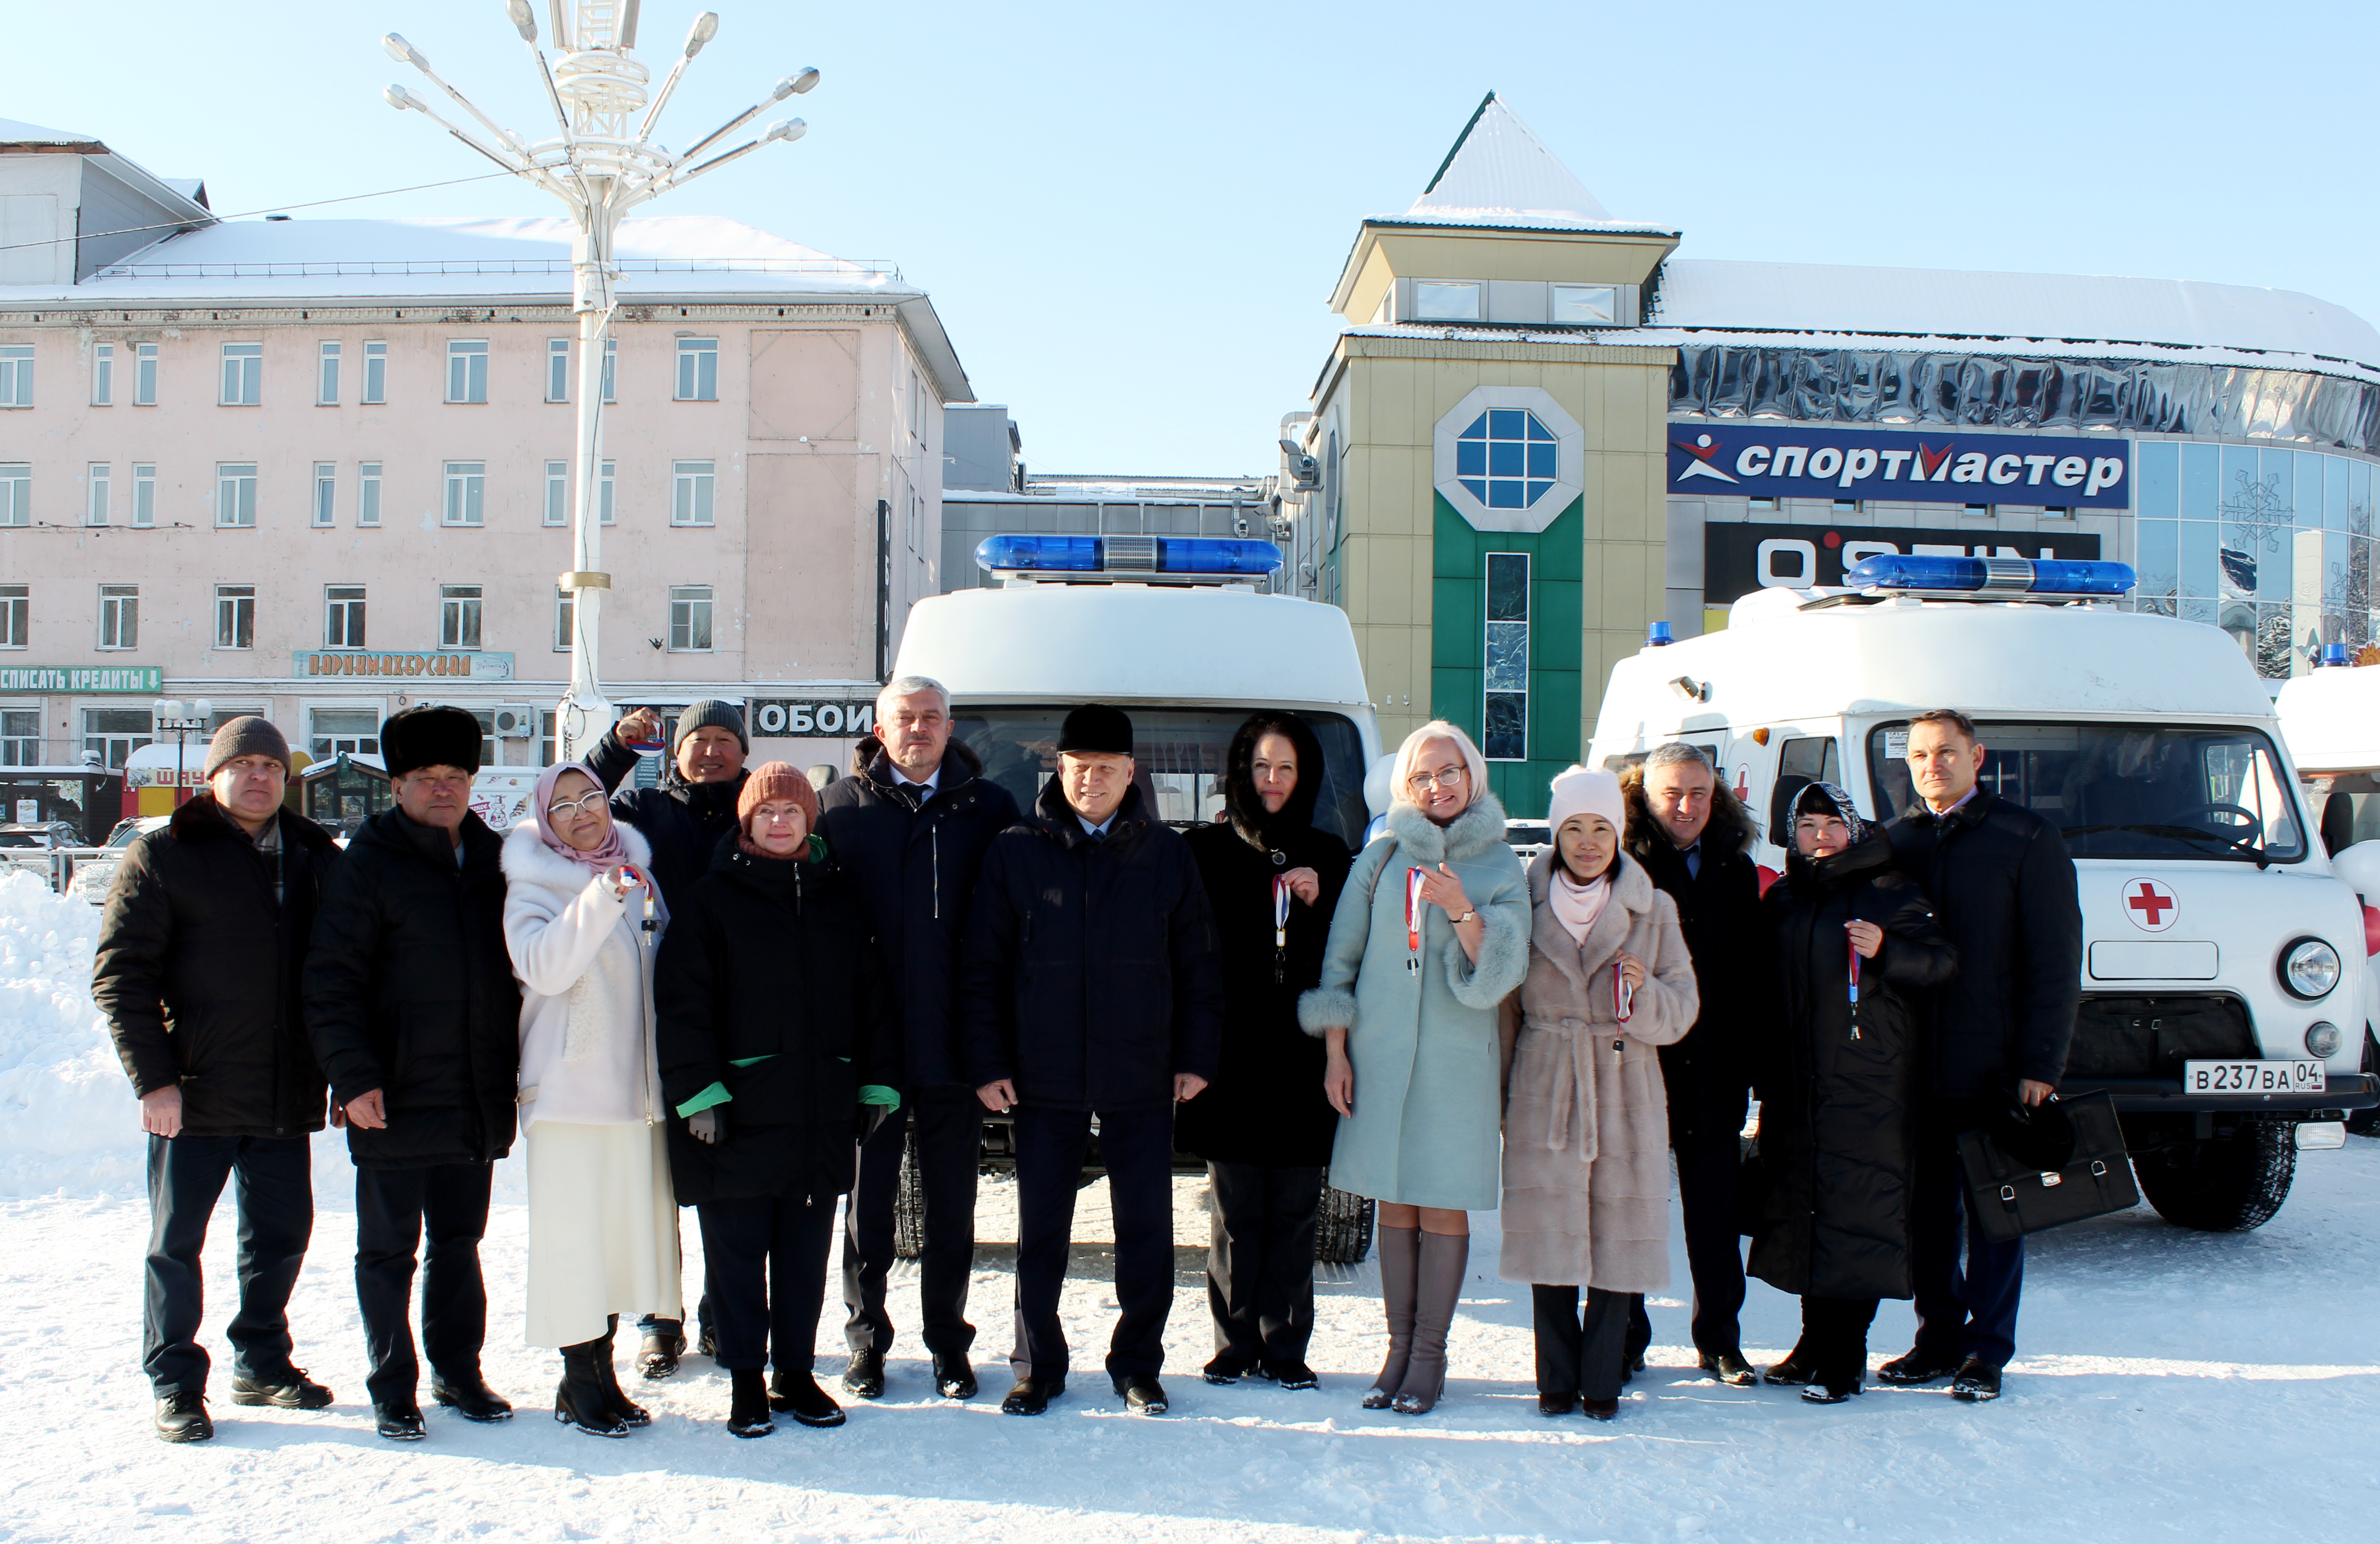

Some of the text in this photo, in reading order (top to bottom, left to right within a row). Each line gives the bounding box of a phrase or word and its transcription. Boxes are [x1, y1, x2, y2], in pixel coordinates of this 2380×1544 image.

[309, 655, 470, 676] ПАРИКМАХЕРСКАЯ
[1, 670, 144, 689] СПИСАТЬ КРЕДИТЫ
[759, 704, 872, 733] ОБОИ
[2297, 1063, 2318, 1082] 04
